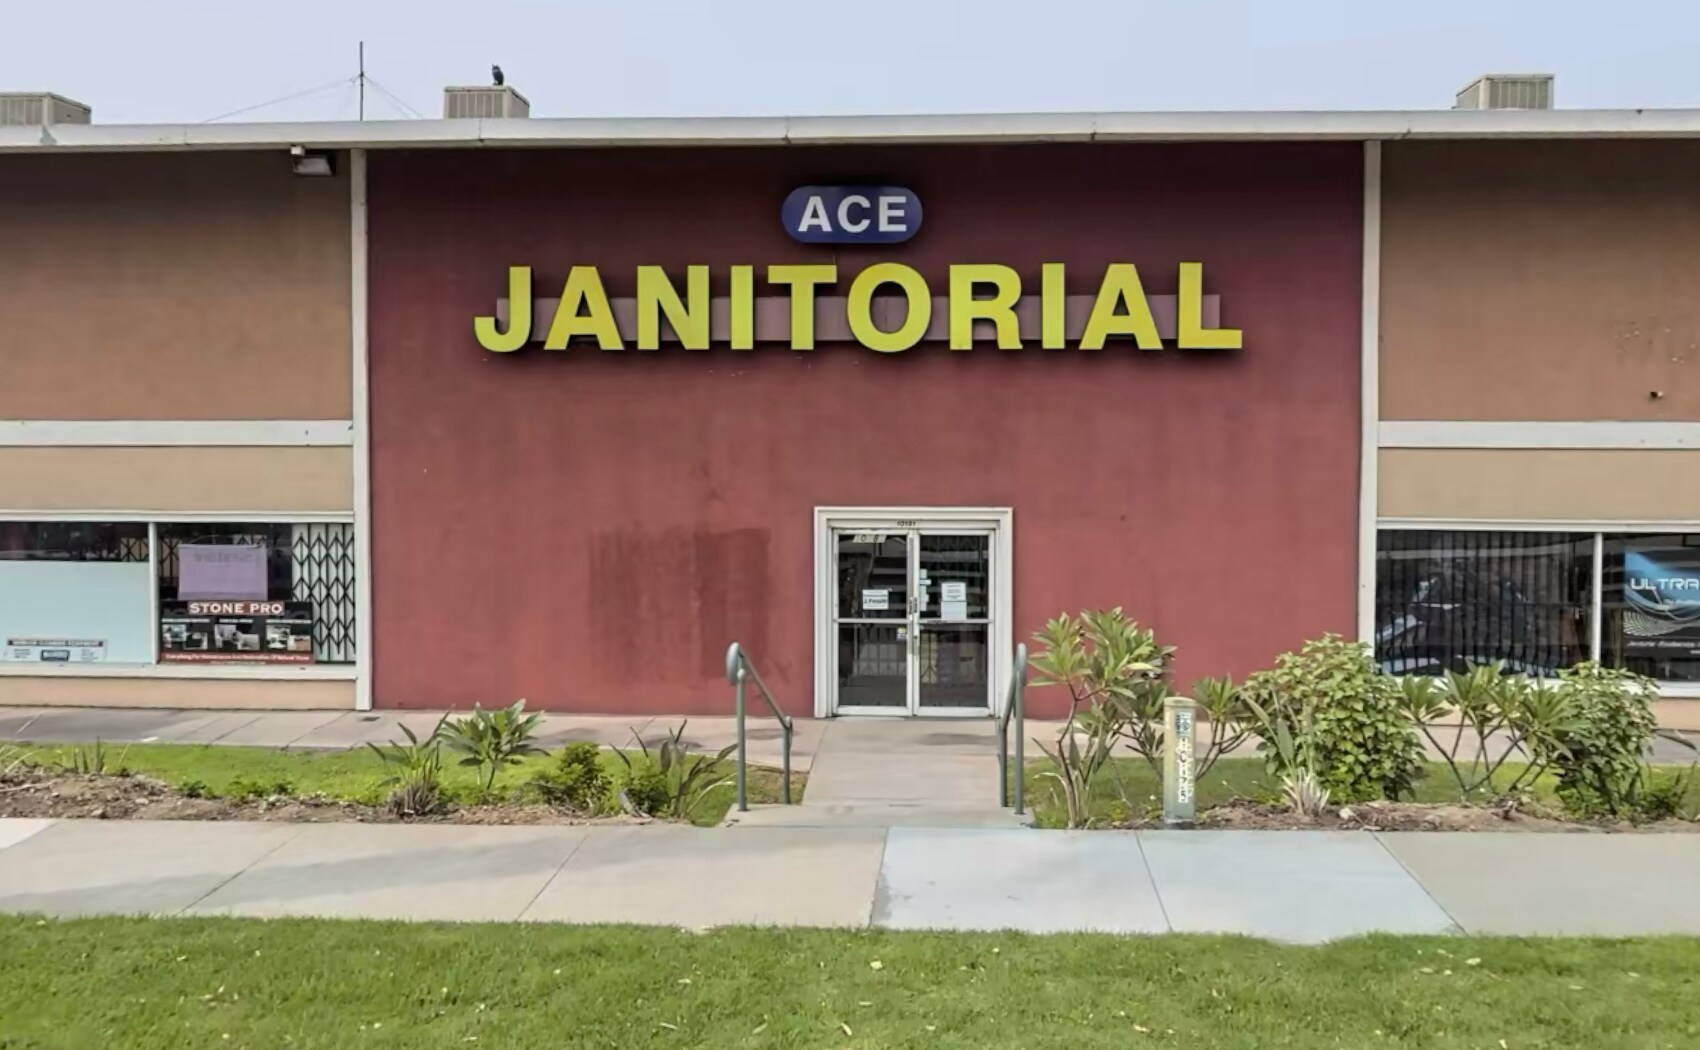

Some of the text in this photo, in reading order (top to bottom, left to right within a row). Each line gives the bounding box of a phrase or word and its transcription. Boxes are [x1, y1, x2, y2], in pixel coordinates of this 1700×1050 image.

[798, 196, 907, 232] ACE
[475, 263, 1242, 352] JANITORIAL
[1630, 578, 1699, 590] ULTRA
[189, 603, 284, 614] STONE PRO
